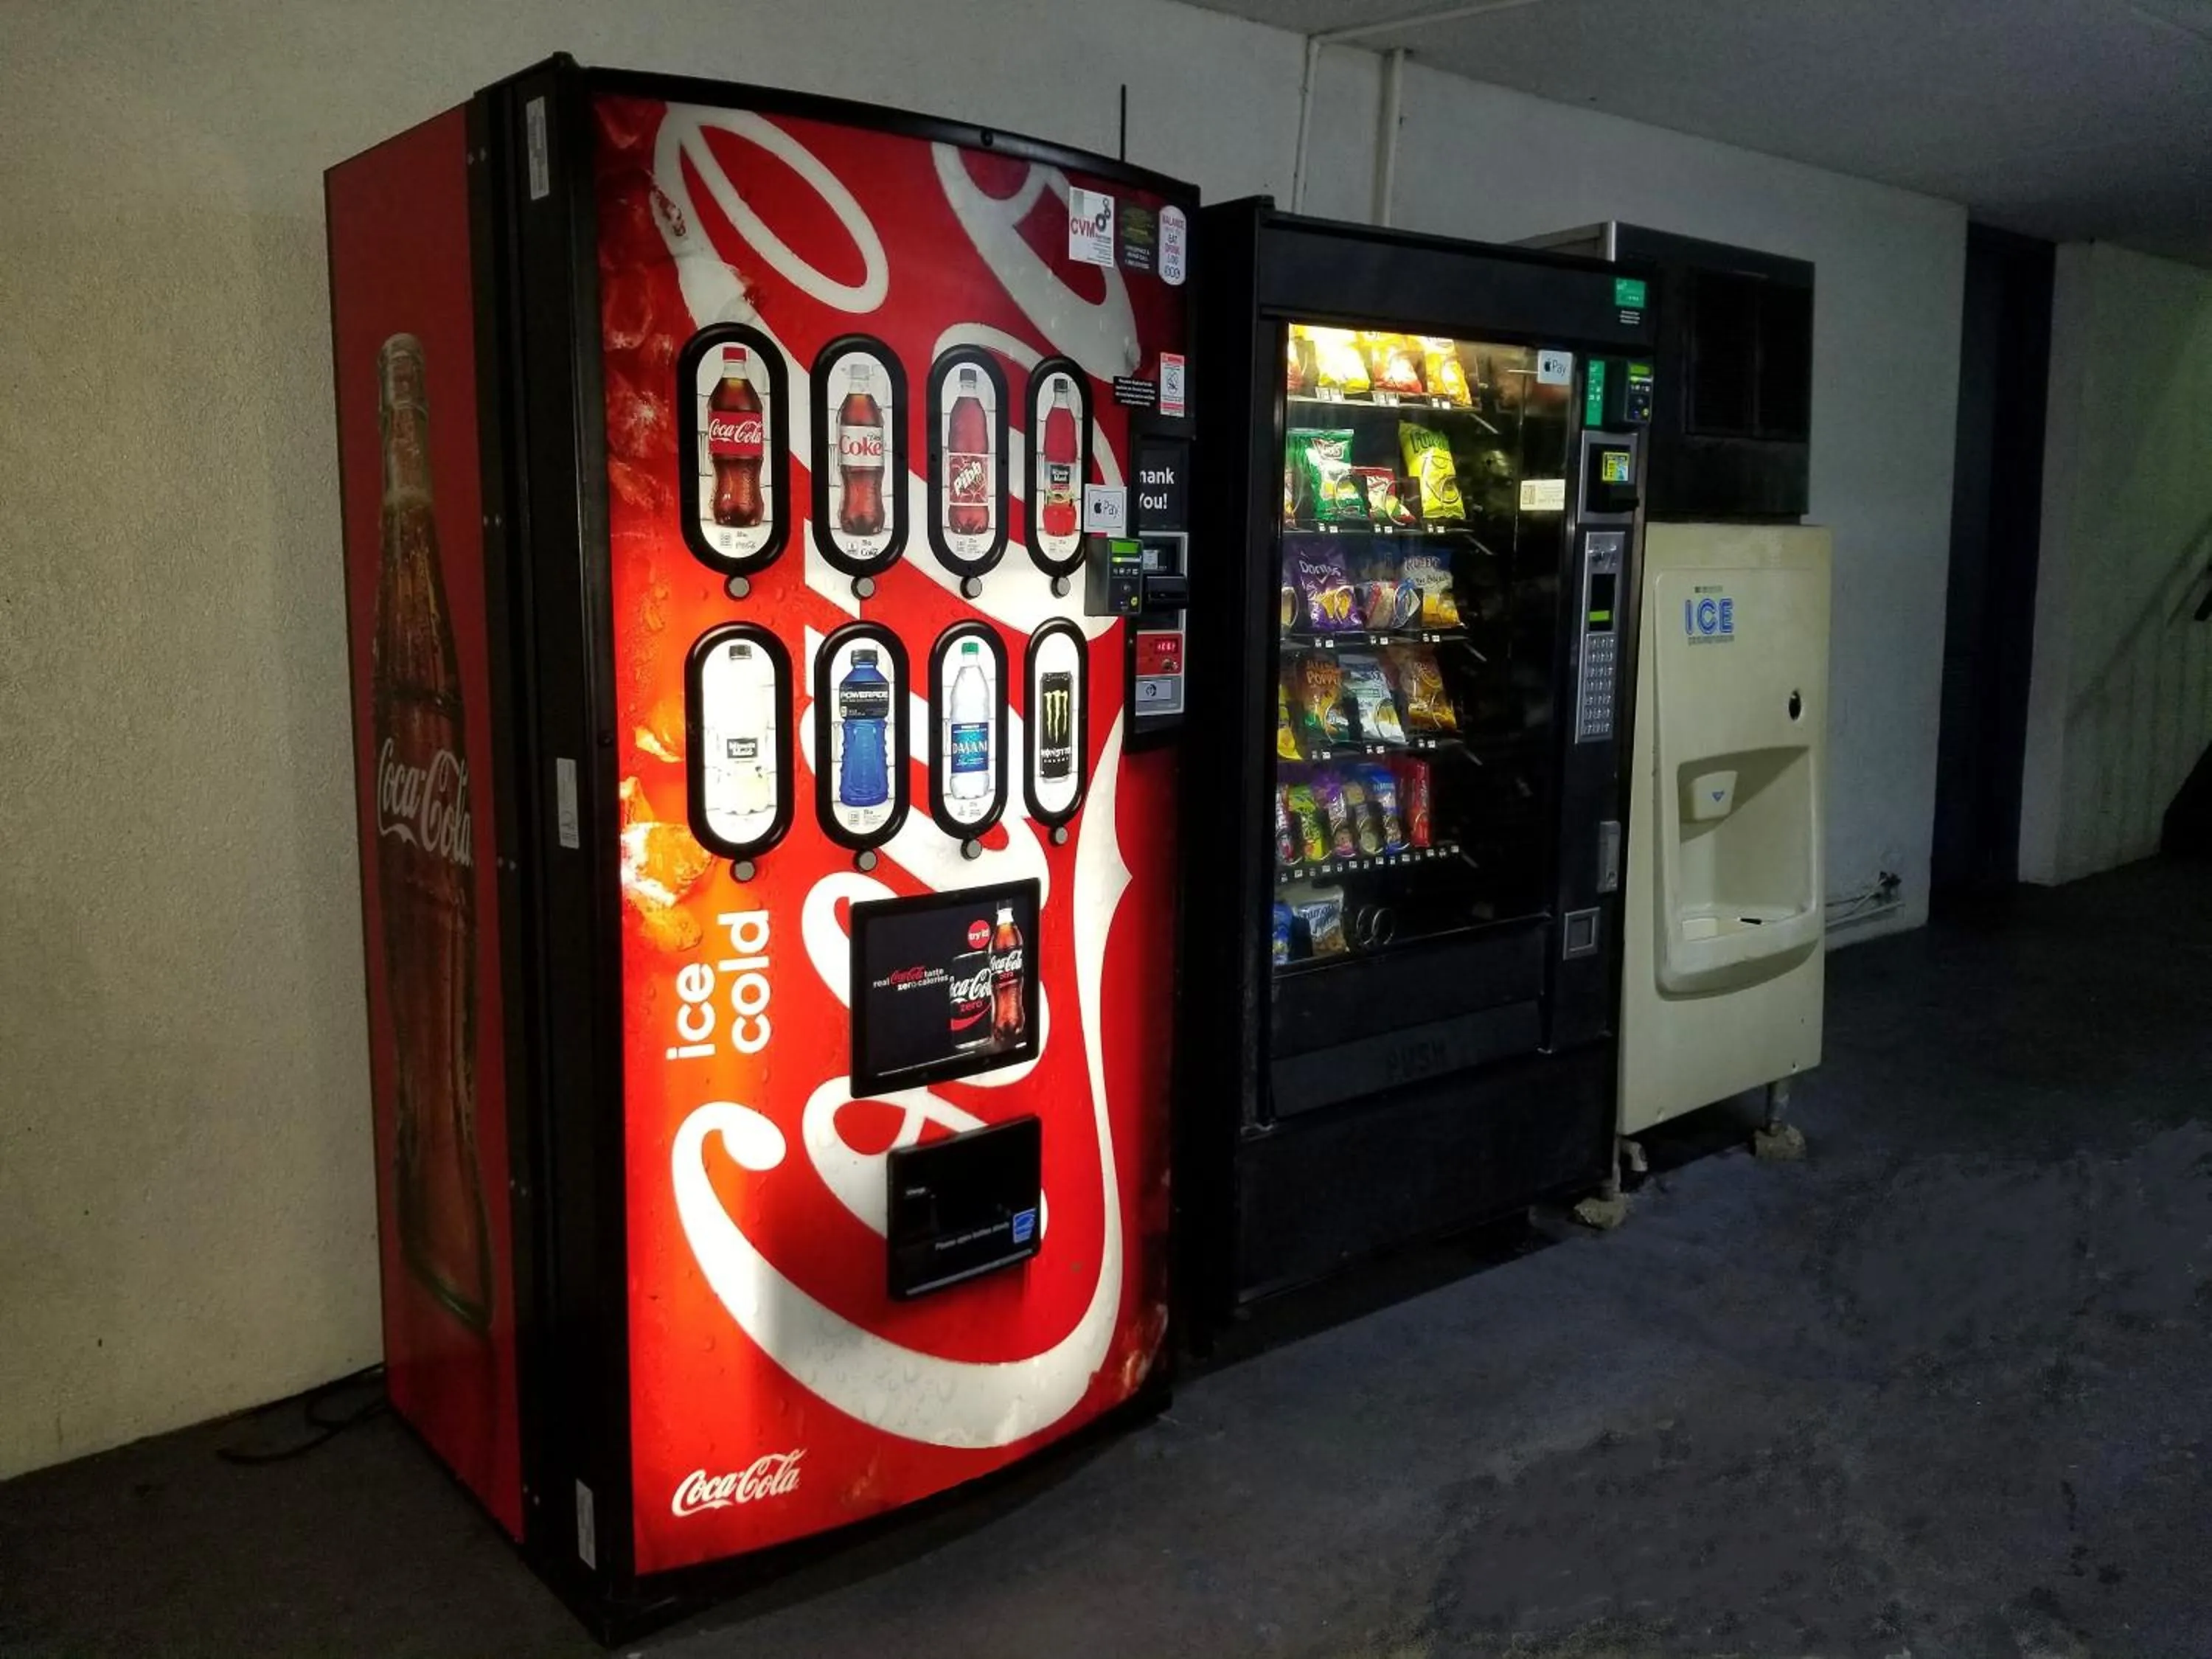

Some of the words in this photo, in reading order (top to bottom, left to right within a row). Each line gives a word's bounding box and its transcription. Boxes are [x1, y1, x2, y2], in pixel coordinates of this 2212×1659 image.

[1071, 218, 1095, 238] CVM
[709, 418, 762, 444] Coca-Cola
[839, 435, 881, 456] Coke
[1139, 467, 1175, 484] hank
[1686, 598, 1733, 636] ICE
[952, 740, 988, 755] DASANI
[377, 737, 473, 868] Coca-Cola
[717, 909, 772, 1054] cold
[873, 977, 889, 988] real
[666, 962, 716, 1060] ice
[960, 999, 984, 1012] zero
[671, 1447, 808, 1517] Coca-Cola
